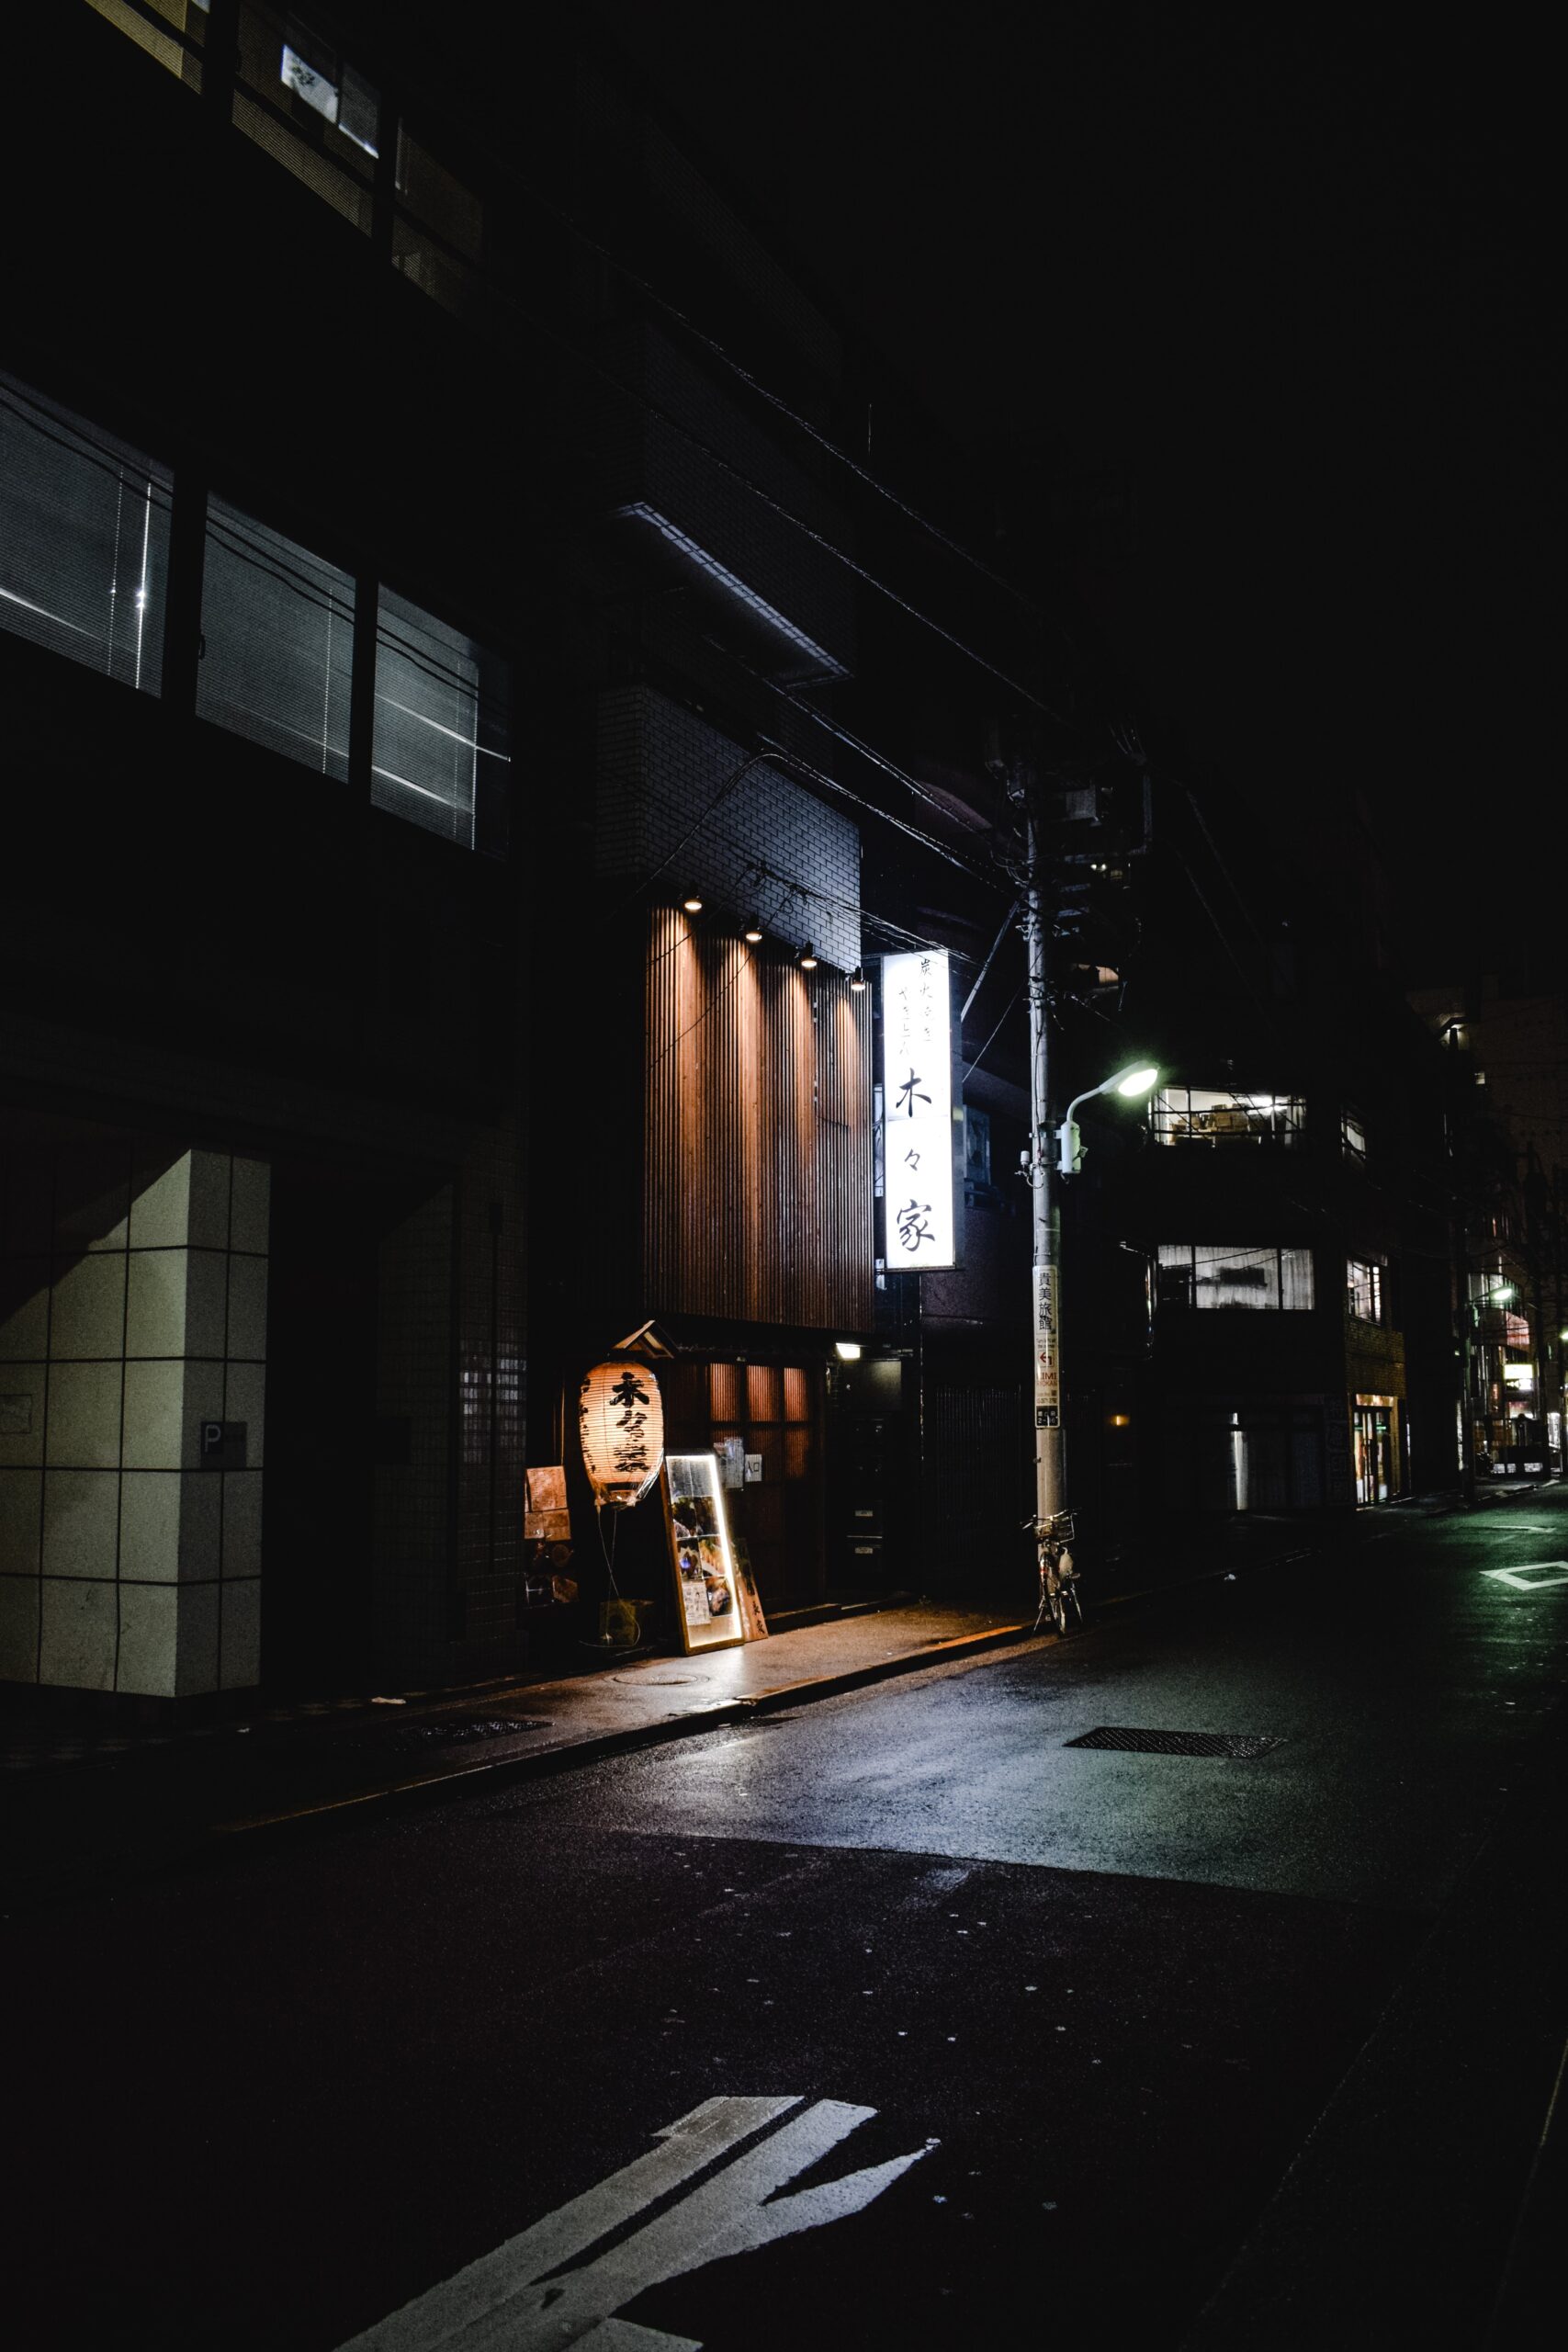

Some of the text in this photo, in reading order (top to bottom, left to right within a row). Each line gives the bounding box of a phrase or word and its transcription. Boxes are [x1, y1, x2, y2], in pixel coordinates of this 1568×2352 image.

[896, 1067, 935, 1252] 木々家
[1038, 1272, 1052, 1330] 貴美旅館
[204, 1424, 221, 1453] P
